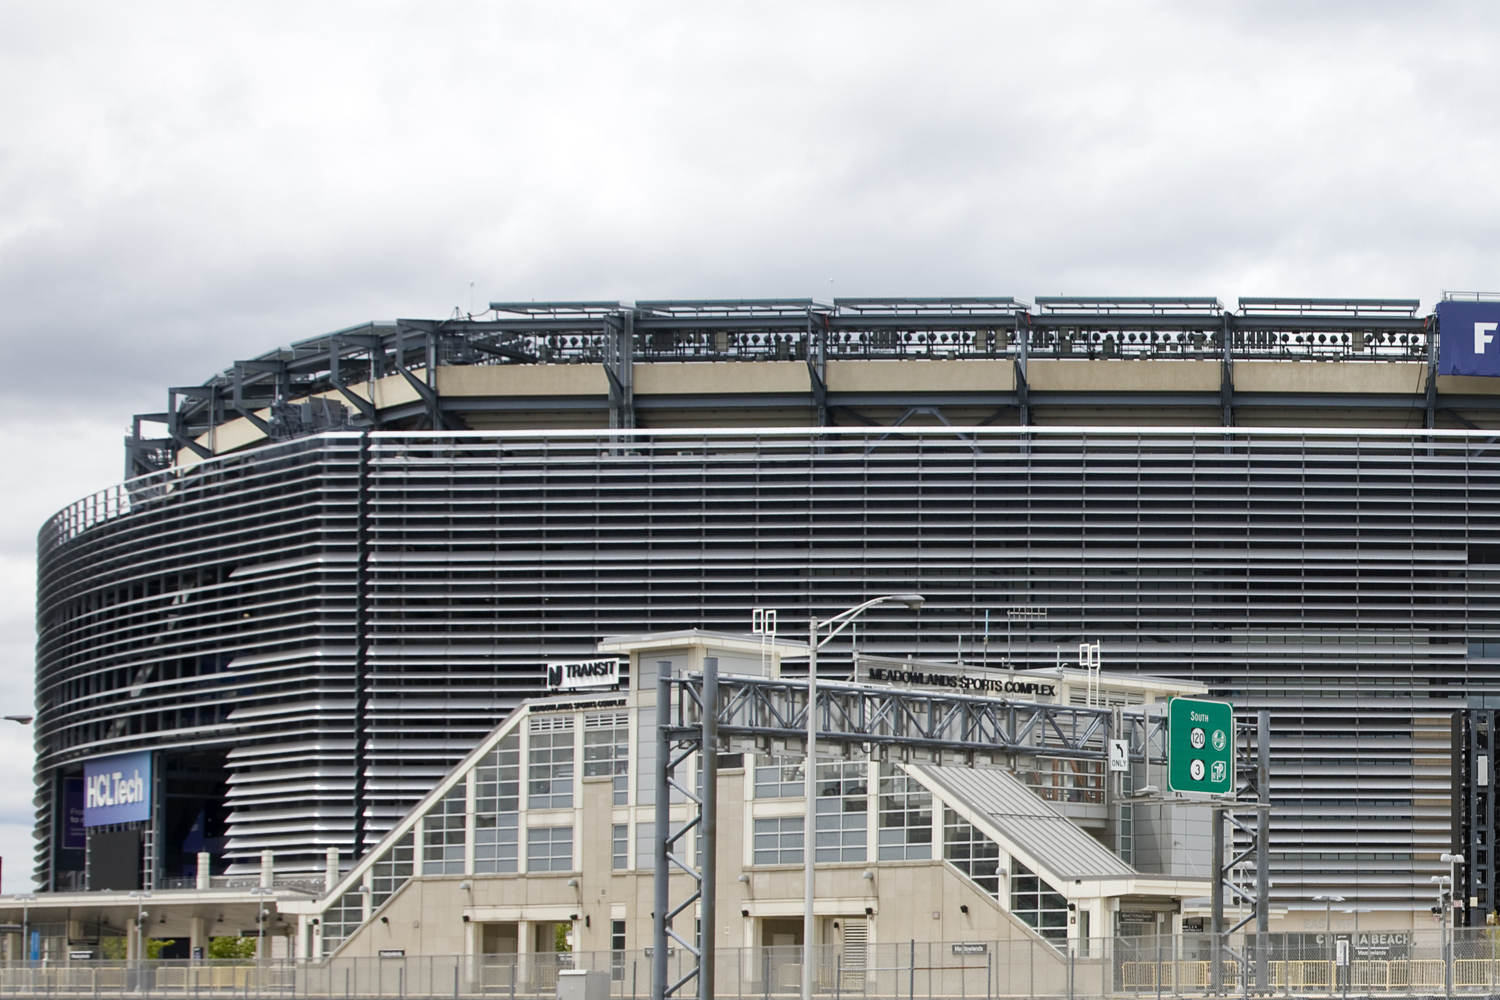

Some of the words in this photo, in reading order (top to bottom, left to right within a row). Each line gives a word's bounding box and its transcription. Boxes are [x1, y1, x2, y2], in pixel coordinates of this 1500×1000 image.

[549, 665, 563, 687] NJ
[565, 660, 616, 678] TRANSIT
[869, 667, 958, 688] MEADOWLANDS
[959, 676, 1003, 692] SPORTS
[1004, 681, 1056, 697] COMPLEX
[1192, 733, 1204, 744] 120
[1111, 759, 1127, 768] ONLY
[1194, 764, 1201, 776] 3
[86, 769, 144, 808] HCLTech
